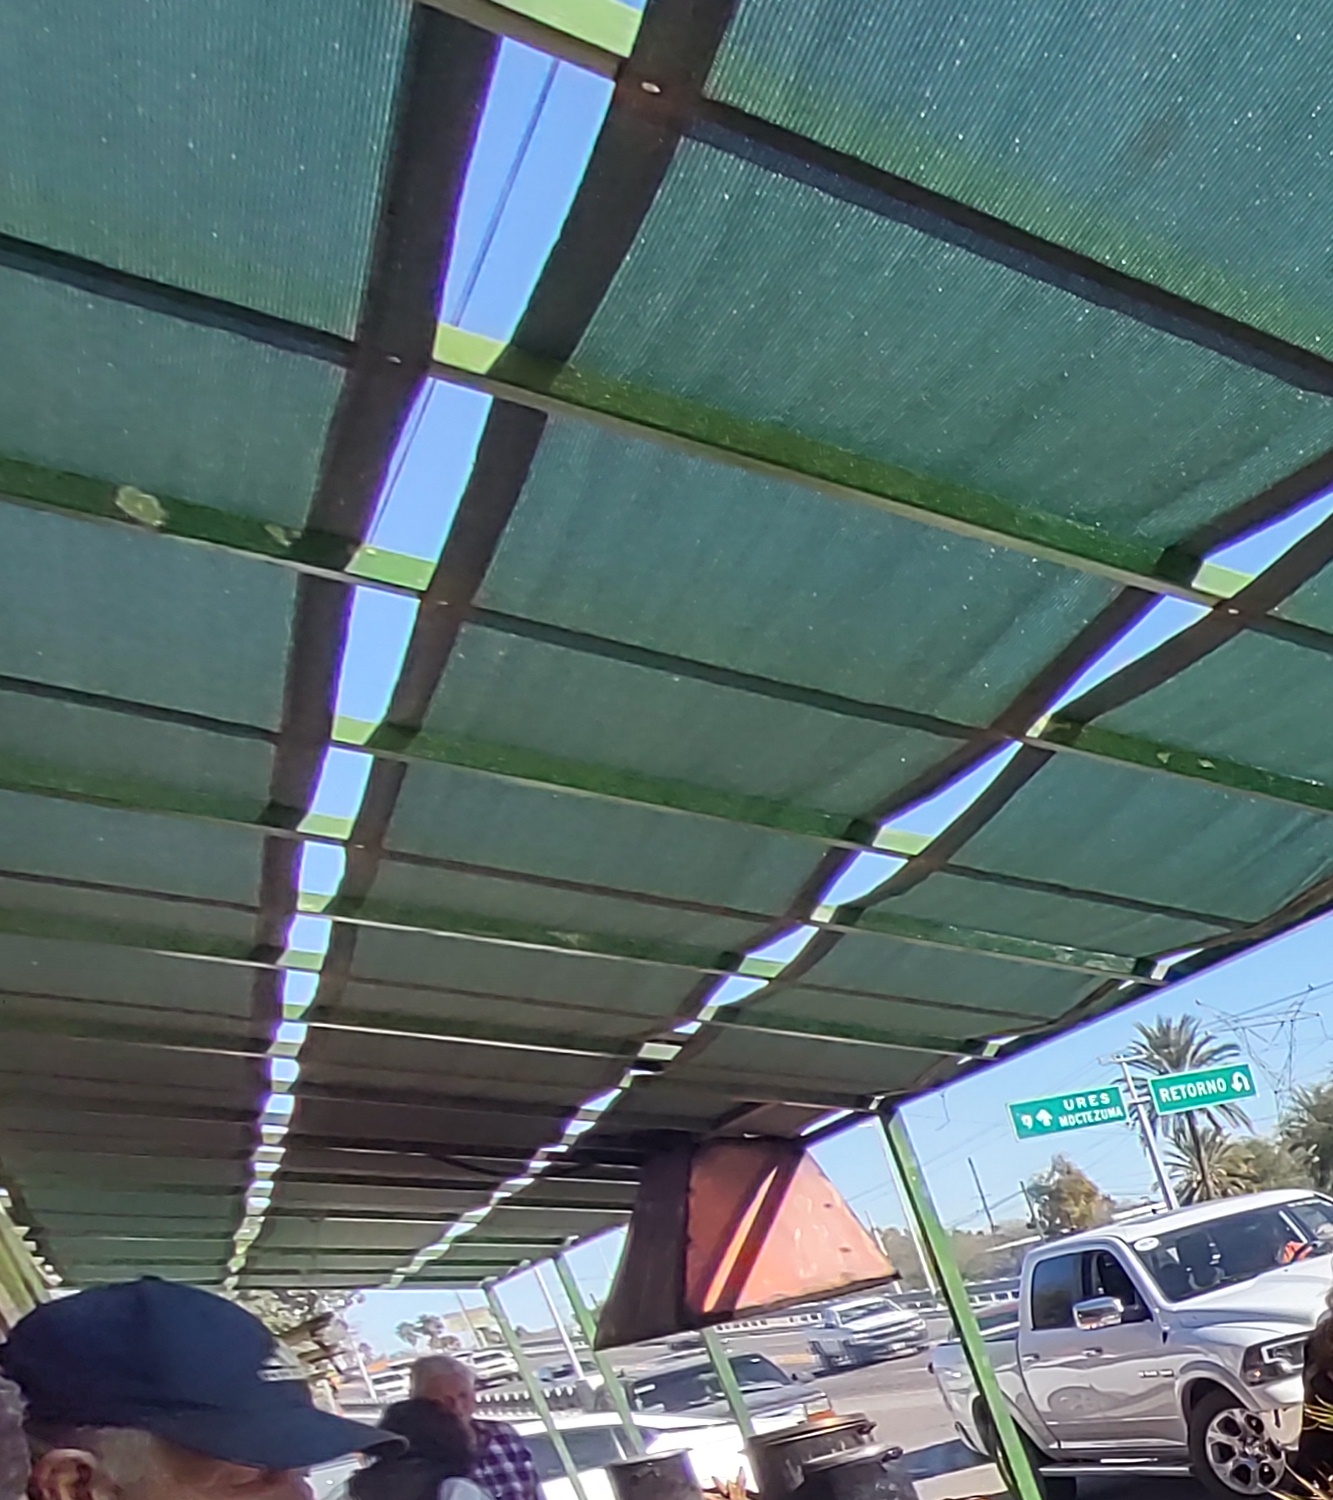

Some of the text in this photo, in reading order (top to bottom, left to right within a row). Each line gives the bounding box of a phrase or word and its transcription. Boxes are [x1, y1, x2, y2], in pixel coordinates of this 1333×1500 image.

[1160, 1078, 1228, 1103] RETORNO
[1063, 1092, 1111, 1111] URES
[1058, 1106, 1123, 1127] MOCTEZUMA
